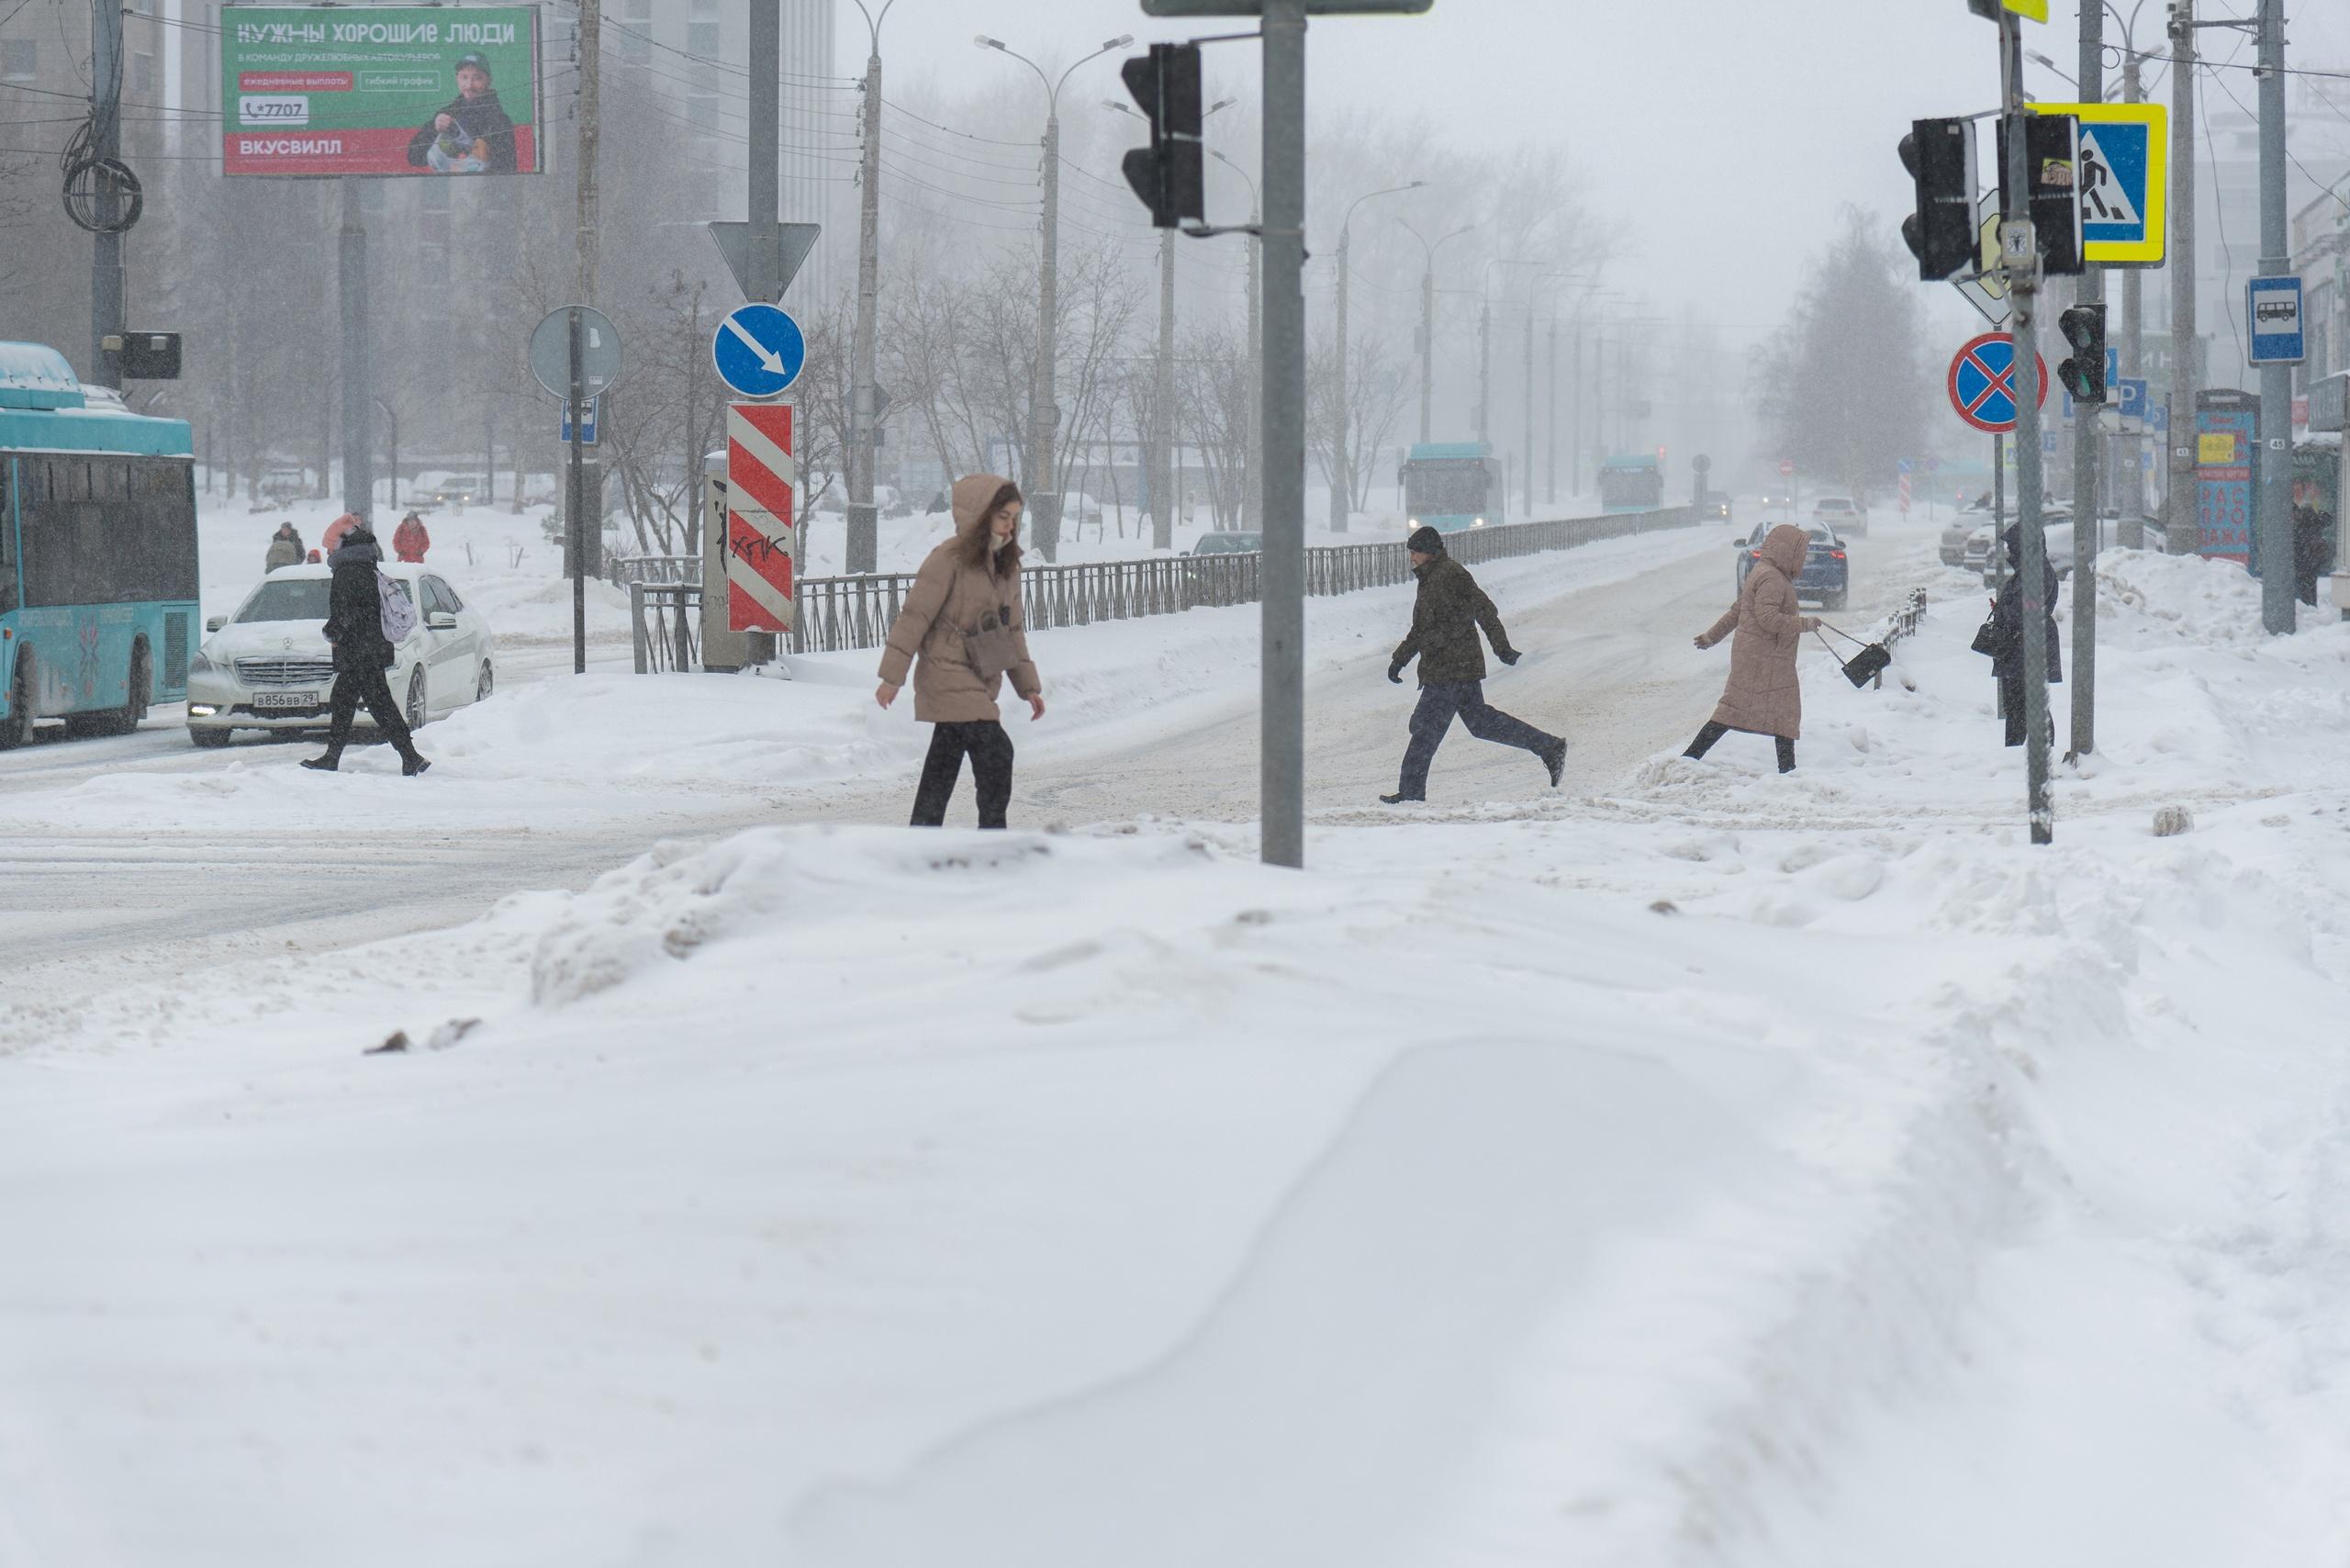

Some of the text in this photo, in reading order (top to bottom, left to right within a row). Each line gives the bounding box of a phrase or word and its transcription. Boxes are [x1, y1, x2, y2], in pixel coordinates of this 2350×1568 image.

[238, 24, 325, 43] НУЖНЫ
[444, 23, 515, 45] ЛЮДИ
[238, 53, 244, 62] В
[246, 53, 293, 62] КОМАНДУ
[244, 77, 305, 86] ежедневные
[365, 75, 433, 86] гибкий график
[240, 140, 341, 155] ВКУСВИЛЛ
